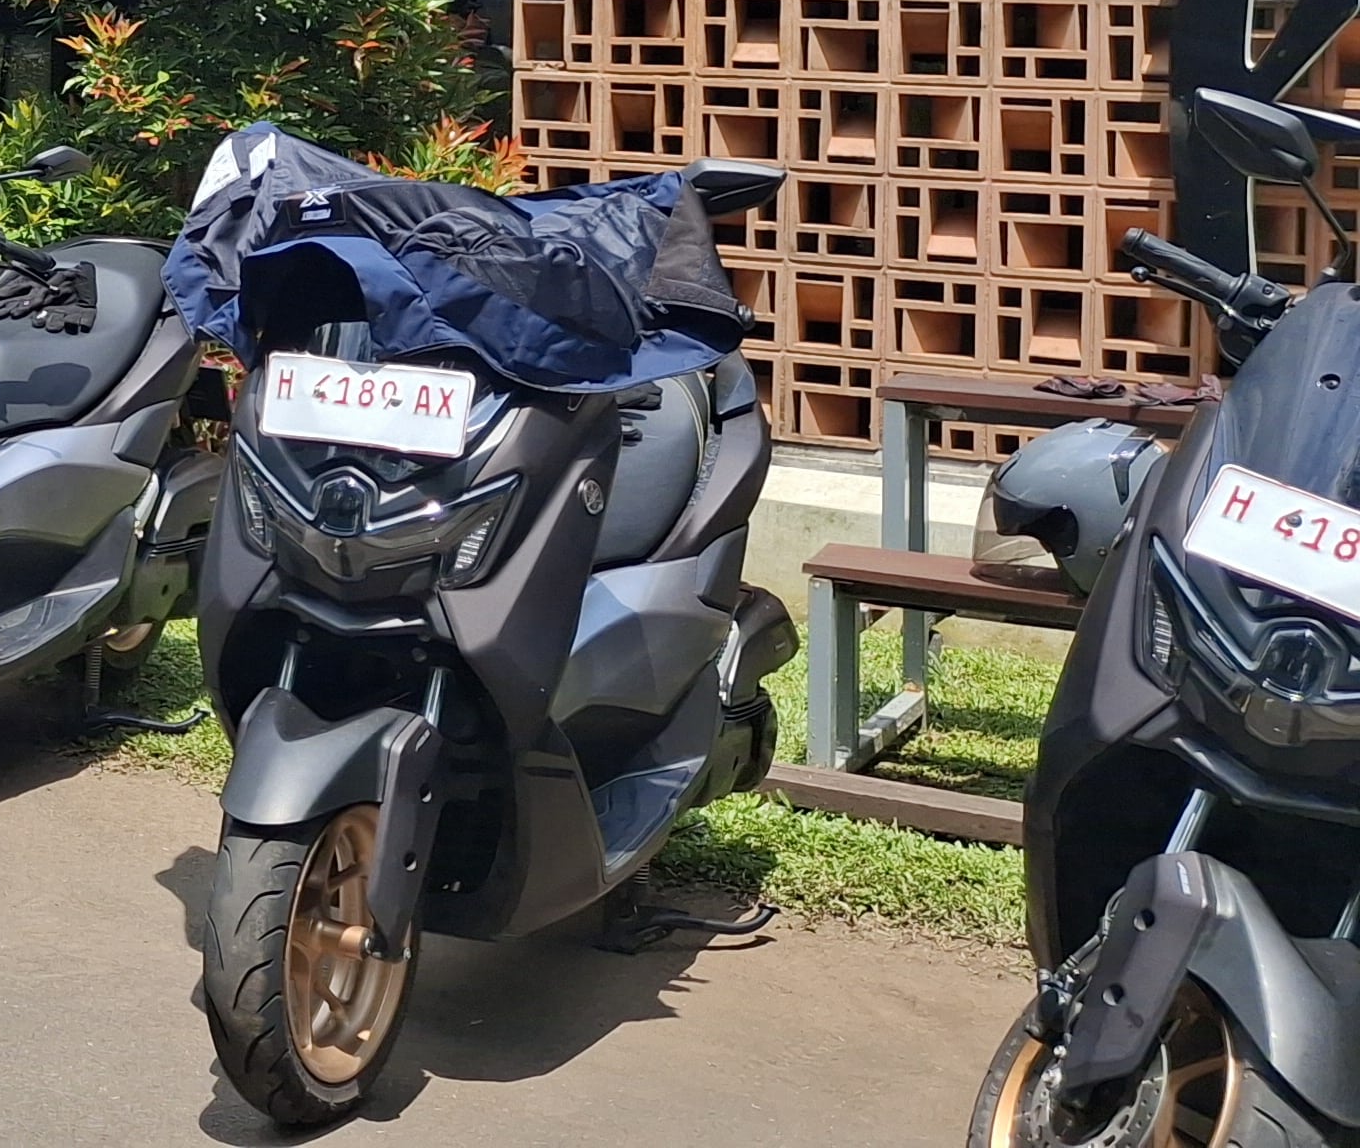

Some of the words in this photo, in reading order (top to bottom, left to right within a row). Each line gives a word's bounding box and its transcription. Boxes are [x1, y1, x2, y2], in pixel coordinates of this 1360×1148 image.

[277, 368, 294, 400] H
[312, 374, 403, 410] 4189
[413, 385, 455, 419] AX
[1222, 485, 1256, 523] H
